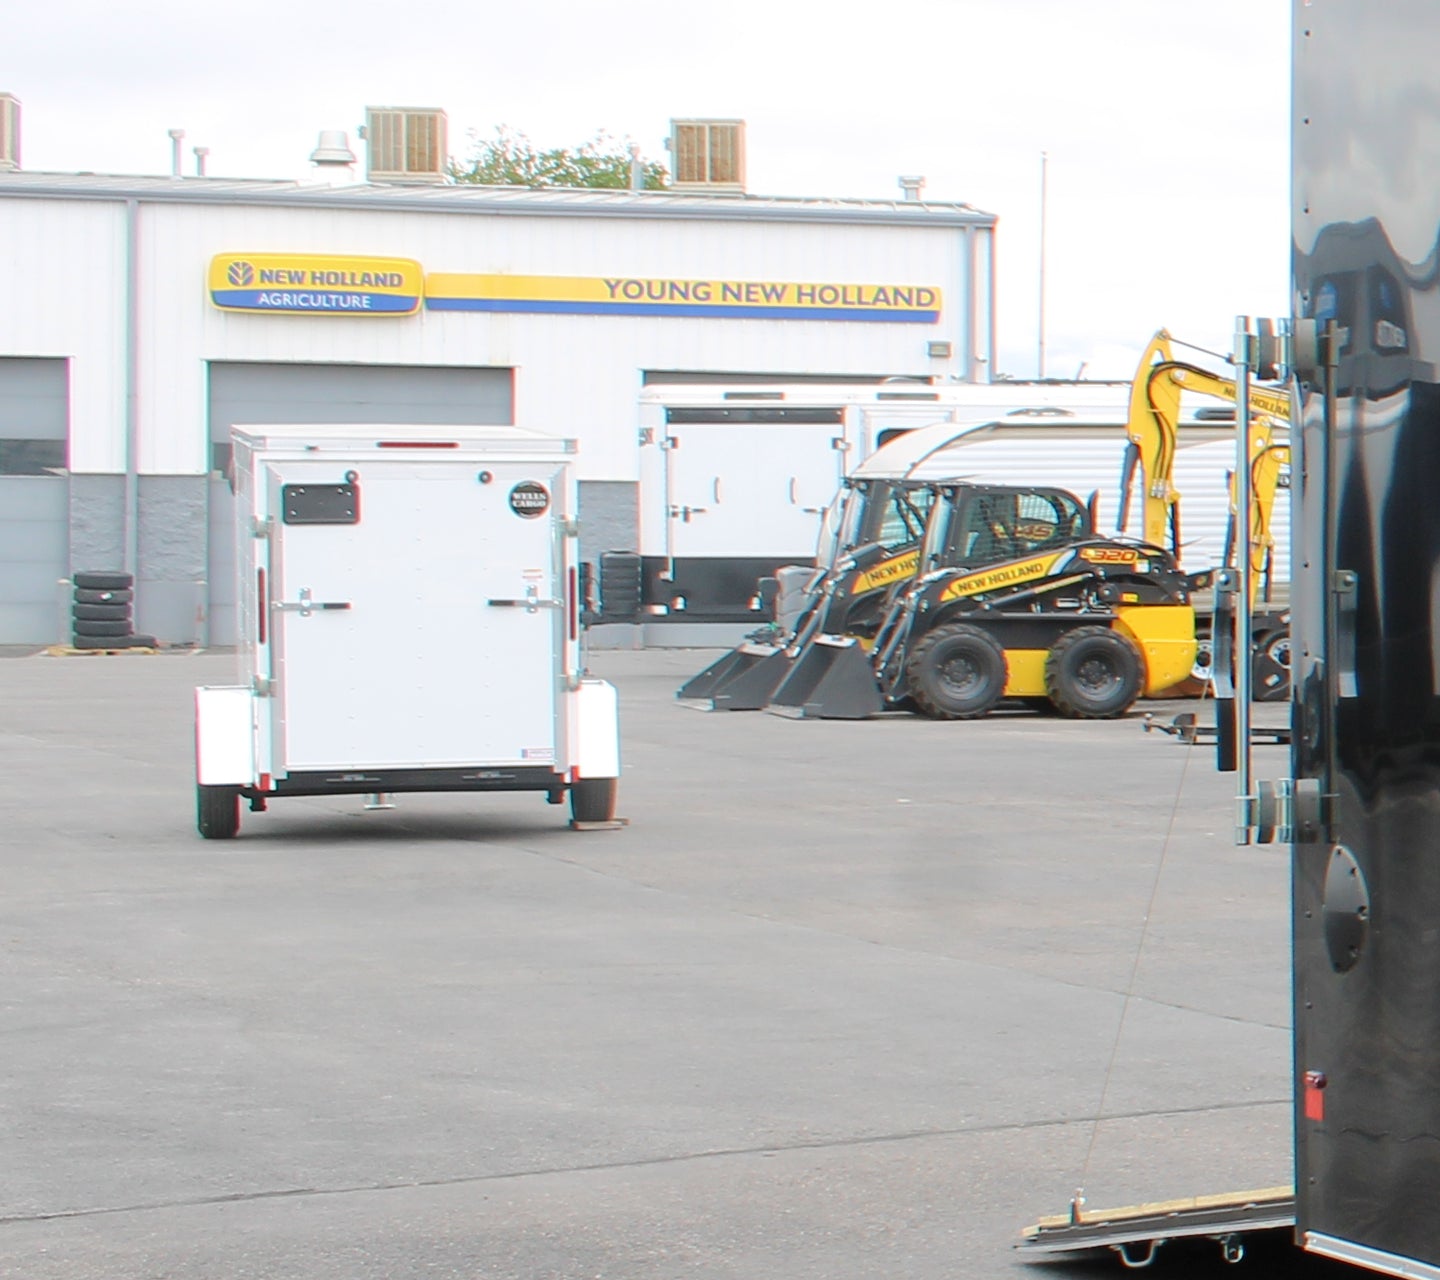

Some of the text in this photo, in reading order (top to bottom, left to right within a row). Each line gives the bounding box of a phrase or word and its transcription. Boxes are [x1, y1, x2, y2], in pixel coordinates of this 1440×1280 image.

[260, 269, 404, 288] NEW HOLLAND
[258, 292, 372, 309] AGRICULTURE
[603, 278, 936, 308] YOUNG NEW HOLLAND
[869, 565, 898, 582] NEW
[958, 562, 1044, 593] NEW HOLLAND
